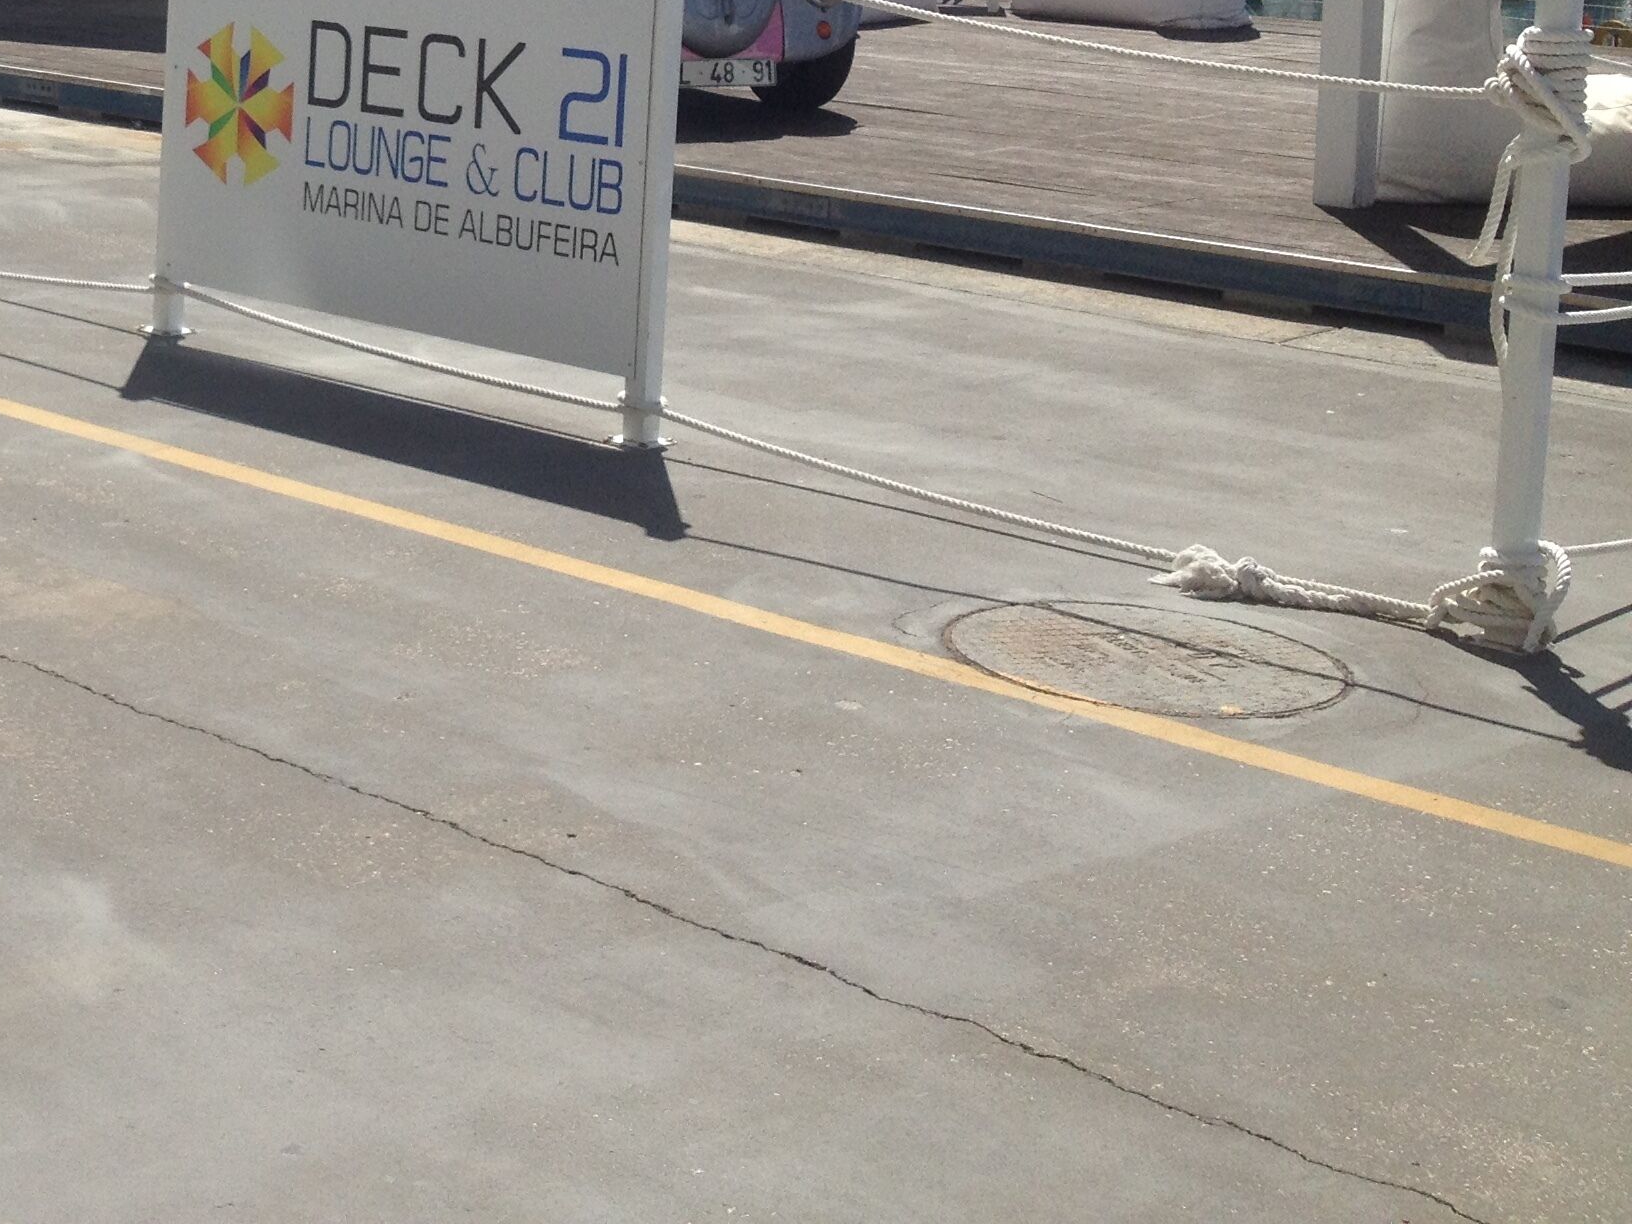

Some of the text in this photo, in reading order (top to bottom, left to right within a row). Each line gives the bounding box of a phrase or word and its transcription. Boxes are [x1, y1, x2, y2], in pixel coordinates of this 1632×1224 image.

[307, 19, 628, 148] DECK 21
[304, 116, 624, 215] LOUNGE & CLUB
[302, 181, 620, 267] MARINA DE ALBUFEIRA
